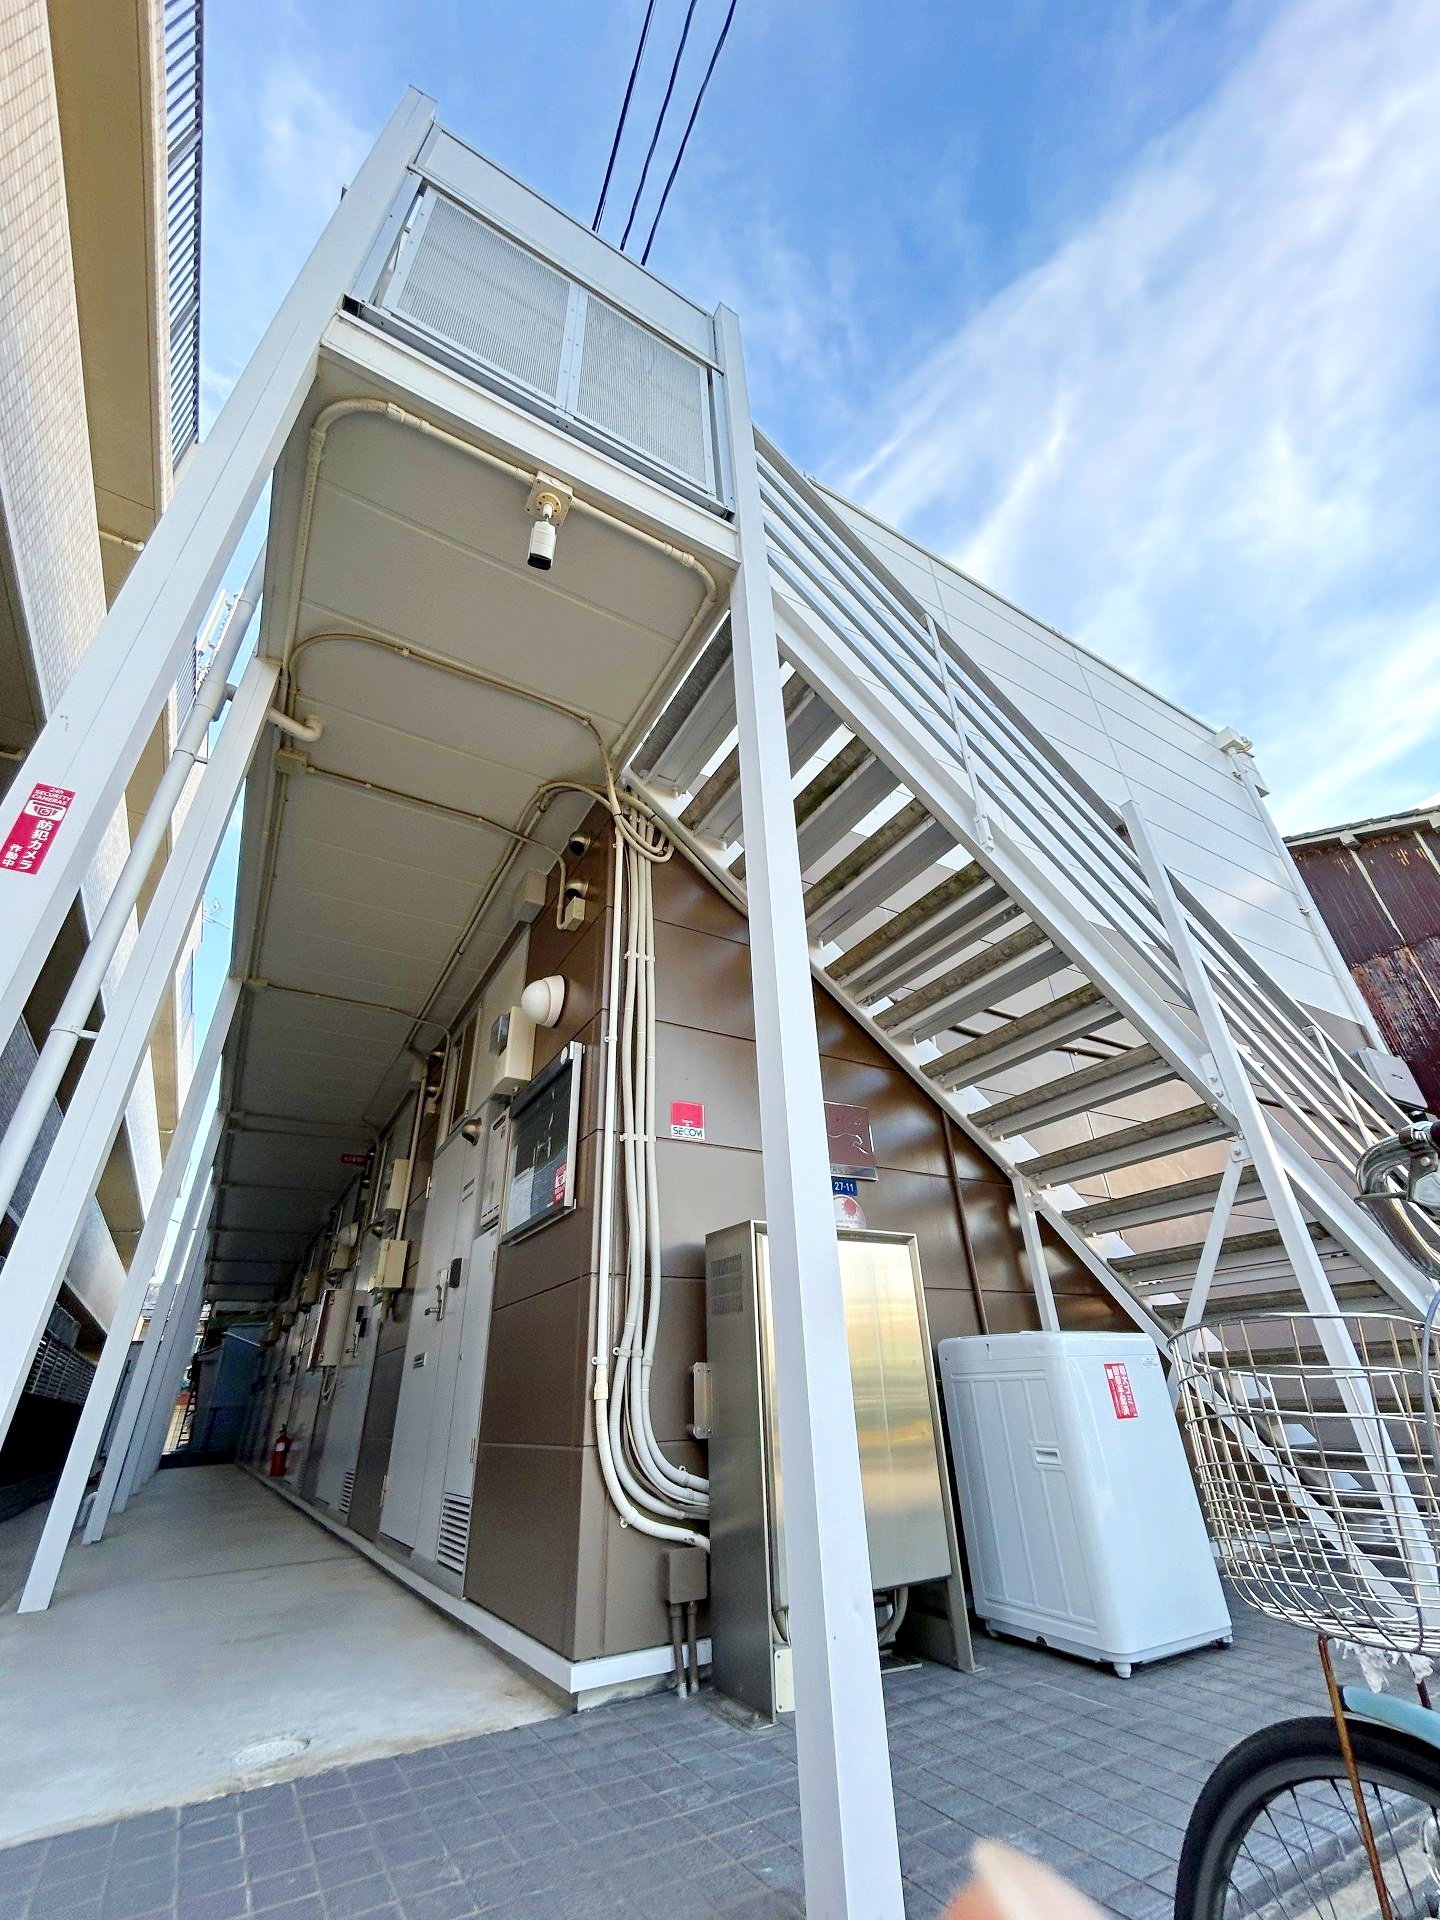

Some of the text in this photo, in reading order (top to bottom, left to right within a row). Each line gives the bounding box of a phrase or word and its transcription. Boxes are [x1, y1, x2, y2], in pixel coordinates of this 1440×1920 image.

[31, 793, 68, 806] CAMERAS
[34, 790, 73, 802] SECURITY
[19, 819, 55, 870] 防犯カメラ
[2, 843, 24, 868] 作動中
[672, 1126, 703, 1138] SECOM
[834, 1181, 854, 1192] 27-11
